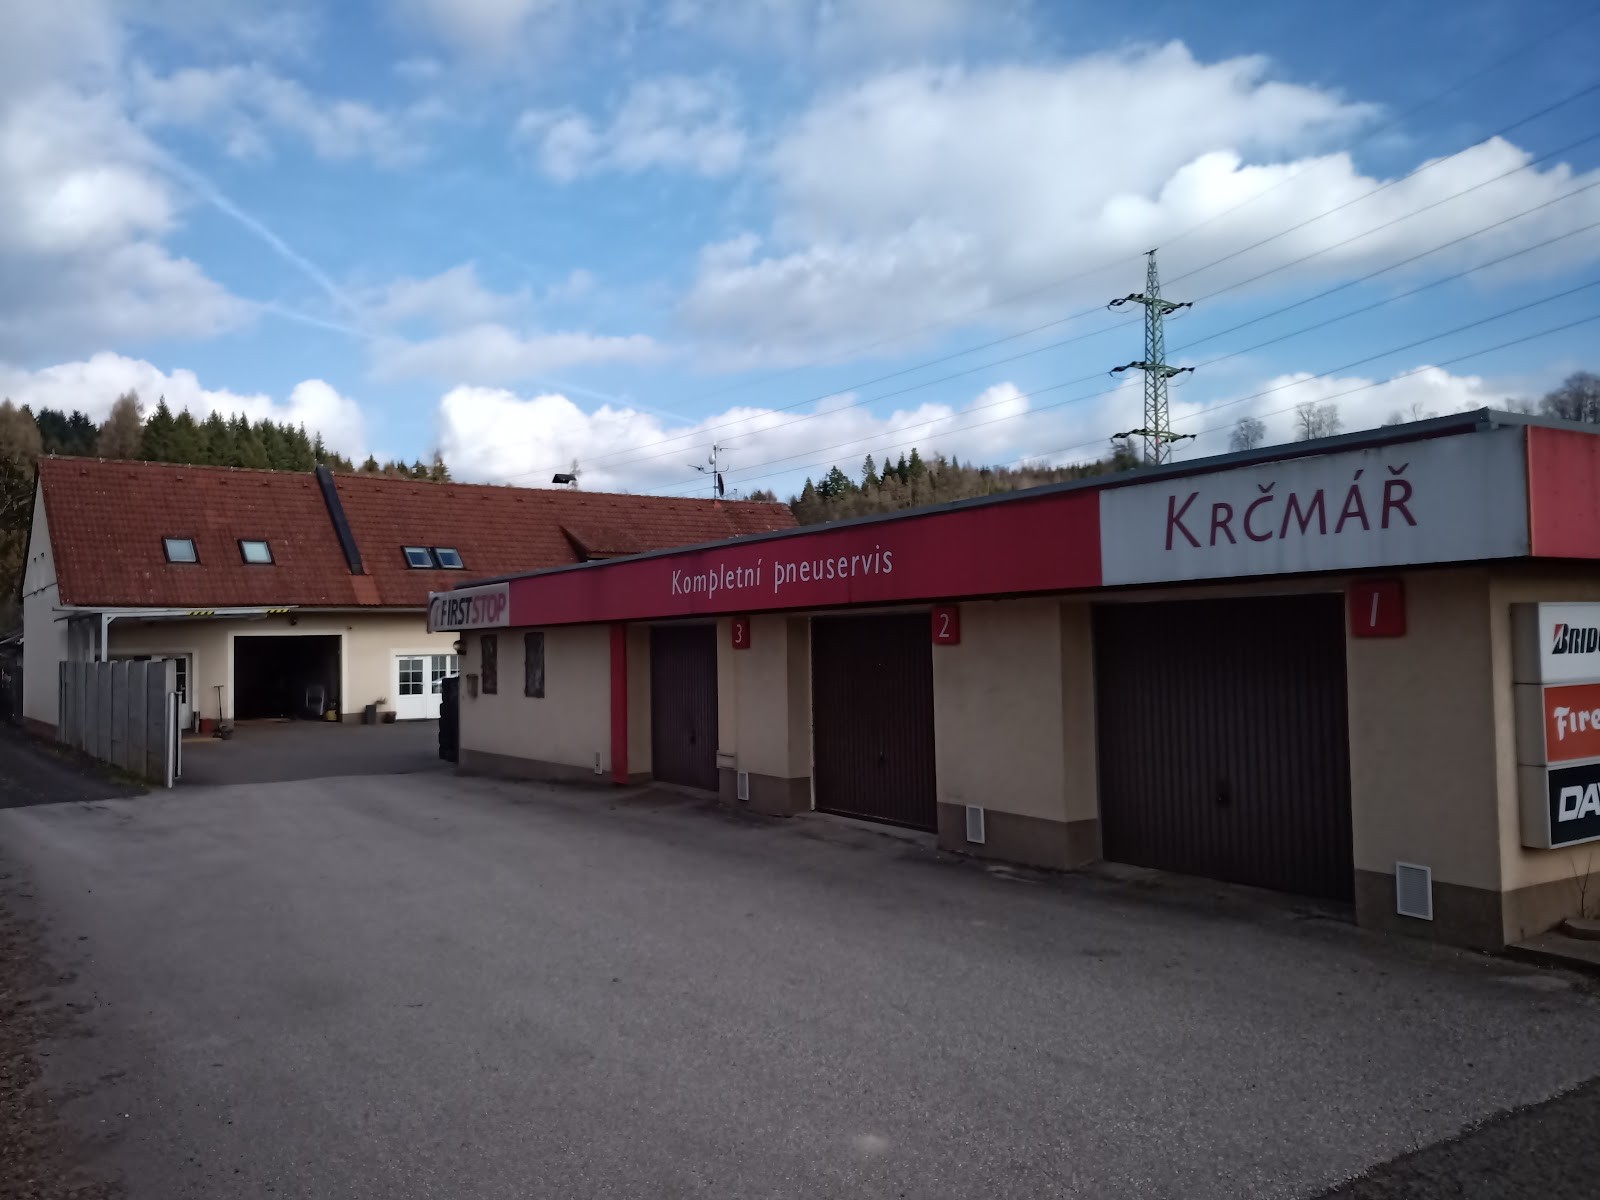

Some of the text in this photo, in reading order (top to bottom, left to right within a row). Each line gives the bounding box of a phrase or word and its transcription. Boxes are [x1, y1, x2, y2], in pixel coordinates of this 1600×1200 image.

[1165, 462, 1417, 550] KRČMÁŘ
[672, 545, 893, 599] Kompletní pneuservis
[734, 624, 743, 643] 3
[938, 613, 951, 638] 2
[1552, 623, 1600, 655] BRID
[1558, 782, 1600, 822] DA
